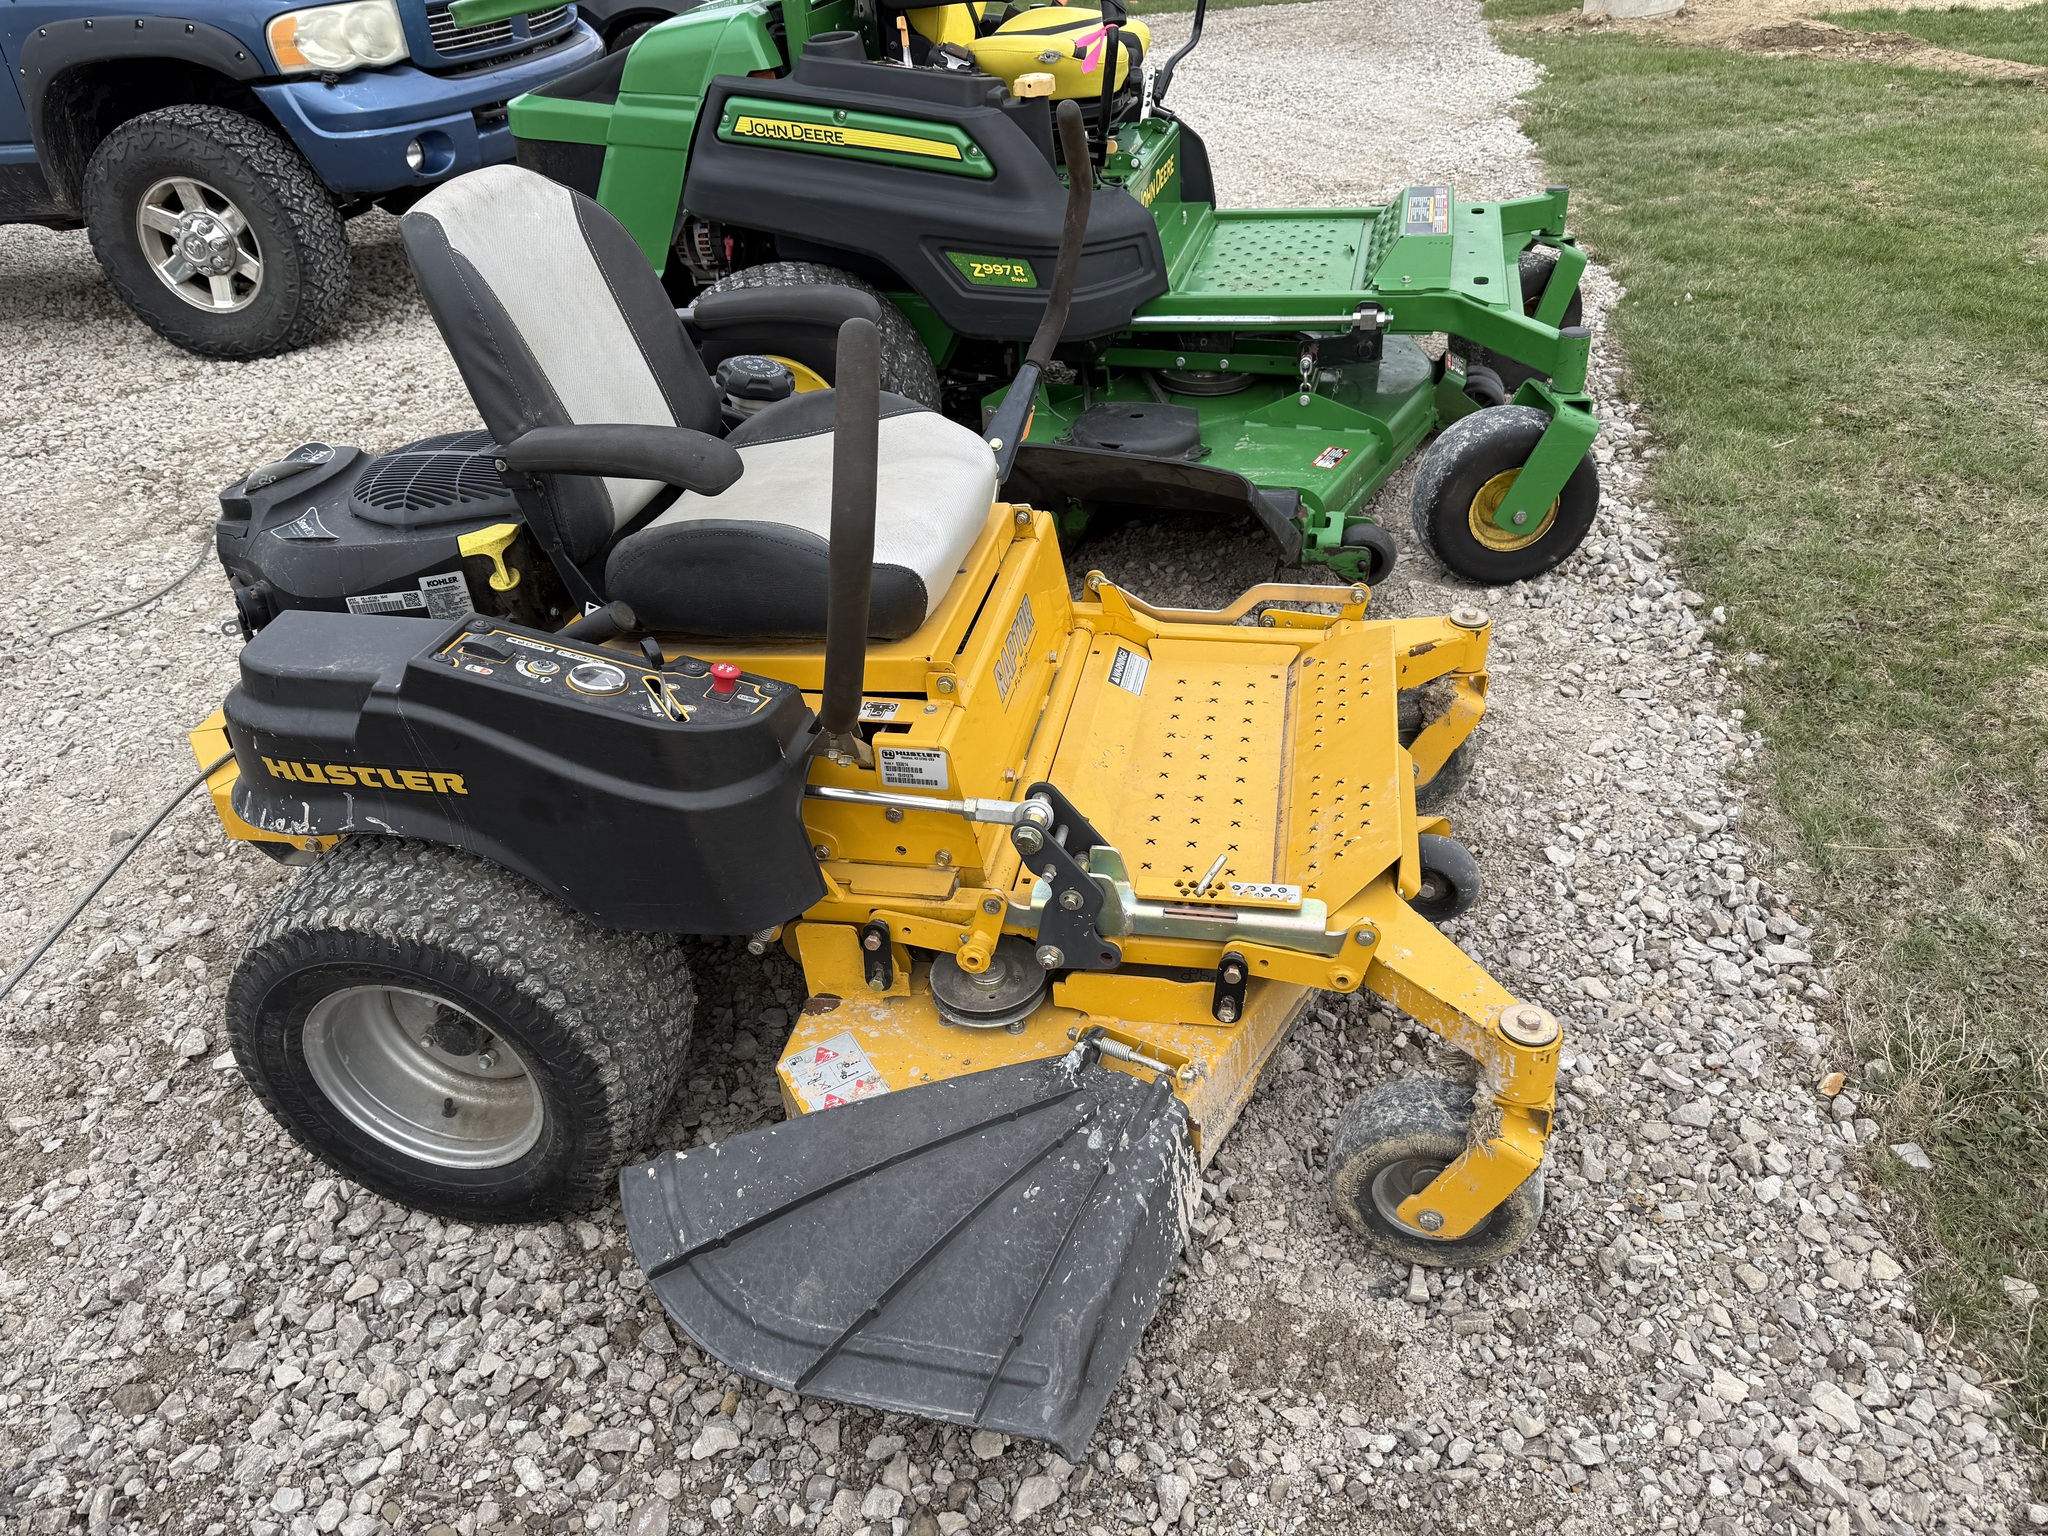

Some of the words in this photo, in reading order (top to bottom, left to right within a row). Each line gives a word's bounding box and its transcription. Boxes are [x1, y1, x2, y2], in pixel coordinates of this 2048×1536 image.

[746, 120, 788, 137] JOHN
[791, 124, 844, 143] DEERE
[1156, 154, 1175, 195] DEERE
[427, 576, 459, 587] KOHLER
[993, 593, 1035, 703] RAPTOR
[261, 756, 469, 795] HUSTLER
